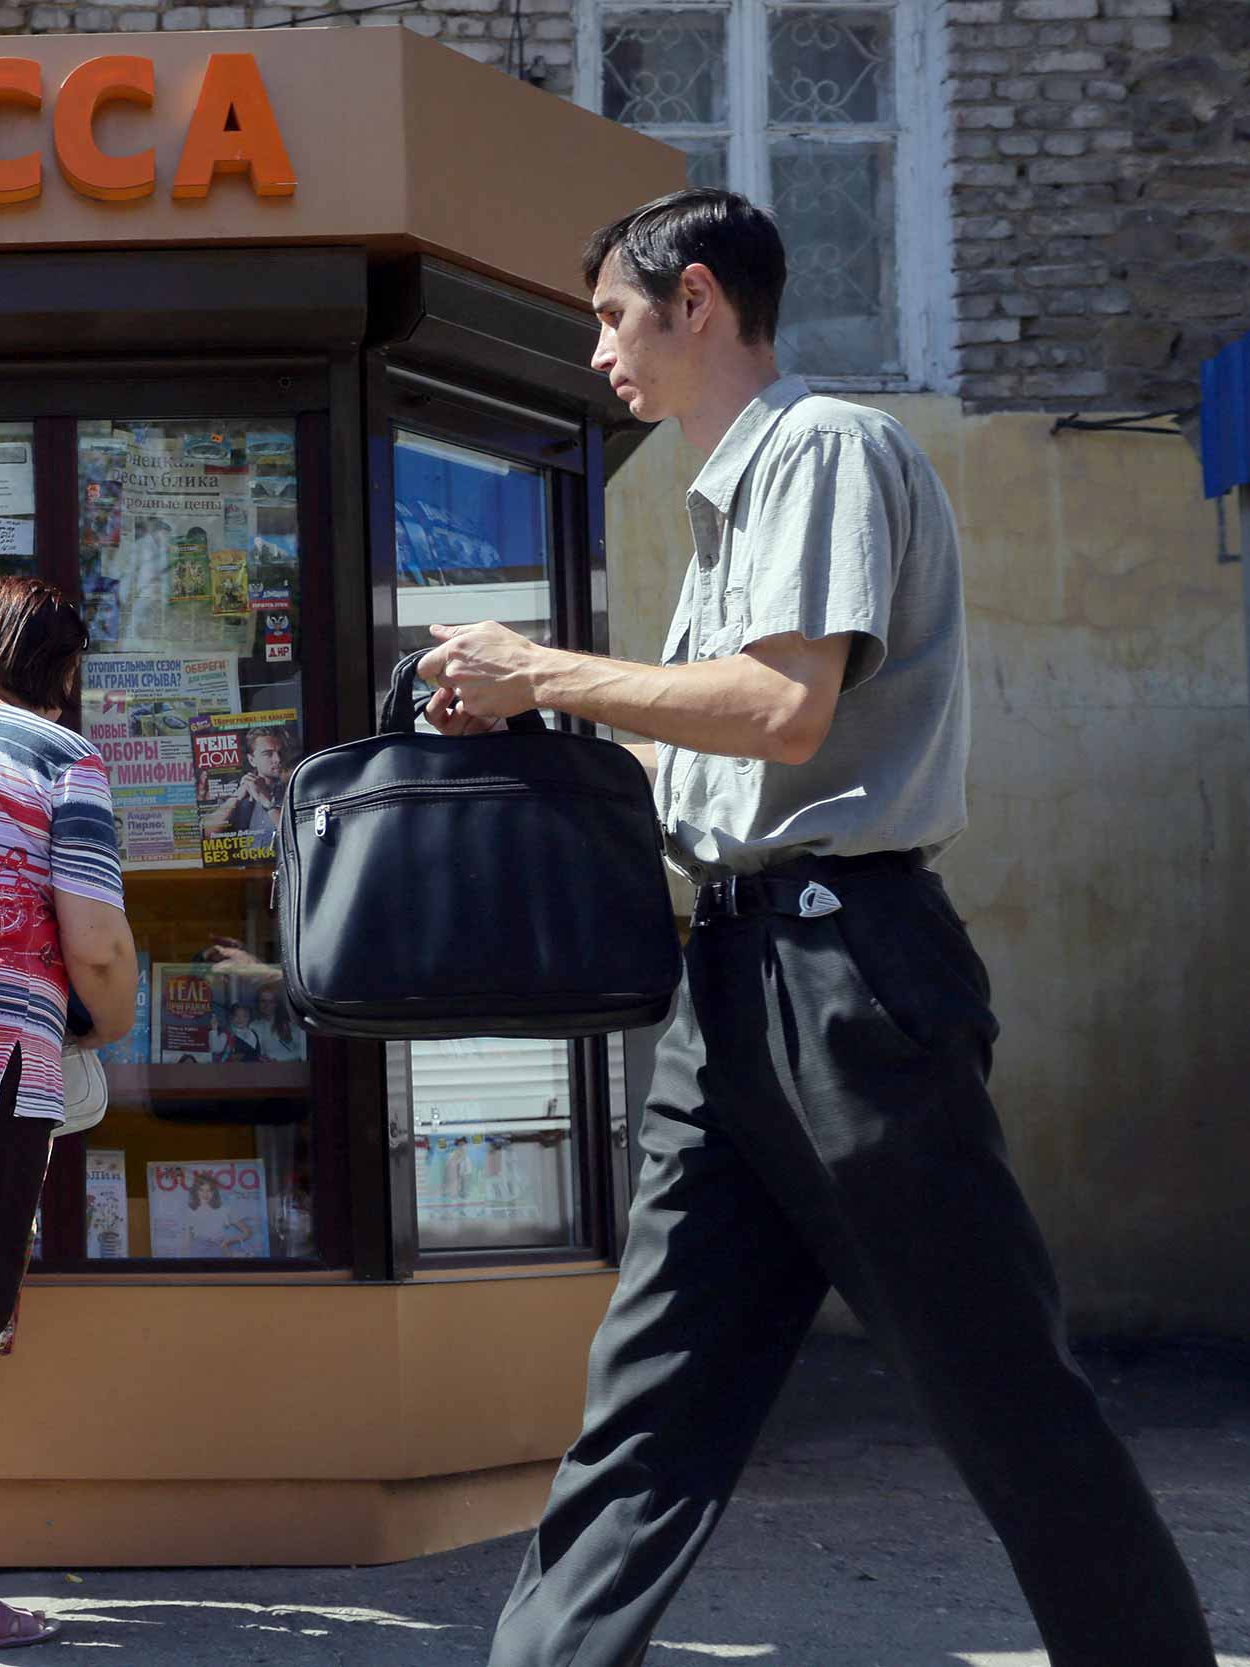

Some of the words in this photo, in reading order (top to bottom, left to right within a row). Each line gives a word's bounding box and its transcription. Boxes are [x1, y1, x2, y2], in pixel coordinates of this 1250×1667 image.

[126, 453, 195, 469] онецкая
[125, 497, 181, 511] родные
[184, 497, 223, 511] цены
[87, 660, 154, 673] ОТОПИТЕЛЬНЫЙ
[156, 660, 181, 672] СЕЗОН
[88, 674, 102, 688] НА
[105, 673, 139, 688] ГРАНИ
[141, 672, 182, 688] СРЫВА?
[90, 722, 127, 739] НОВЫЕ
[99, 740, 159, 762] ОБОРЫ
[196, 735, 238, 753] ТЕЛЕ
[199, 751, 239, 768] ДОМ
[203, 836, 254, 851] МАСТЕР
[204, 851, 229, 863] БЕЗ
[232, 847, 276, 861] «ОСКА
